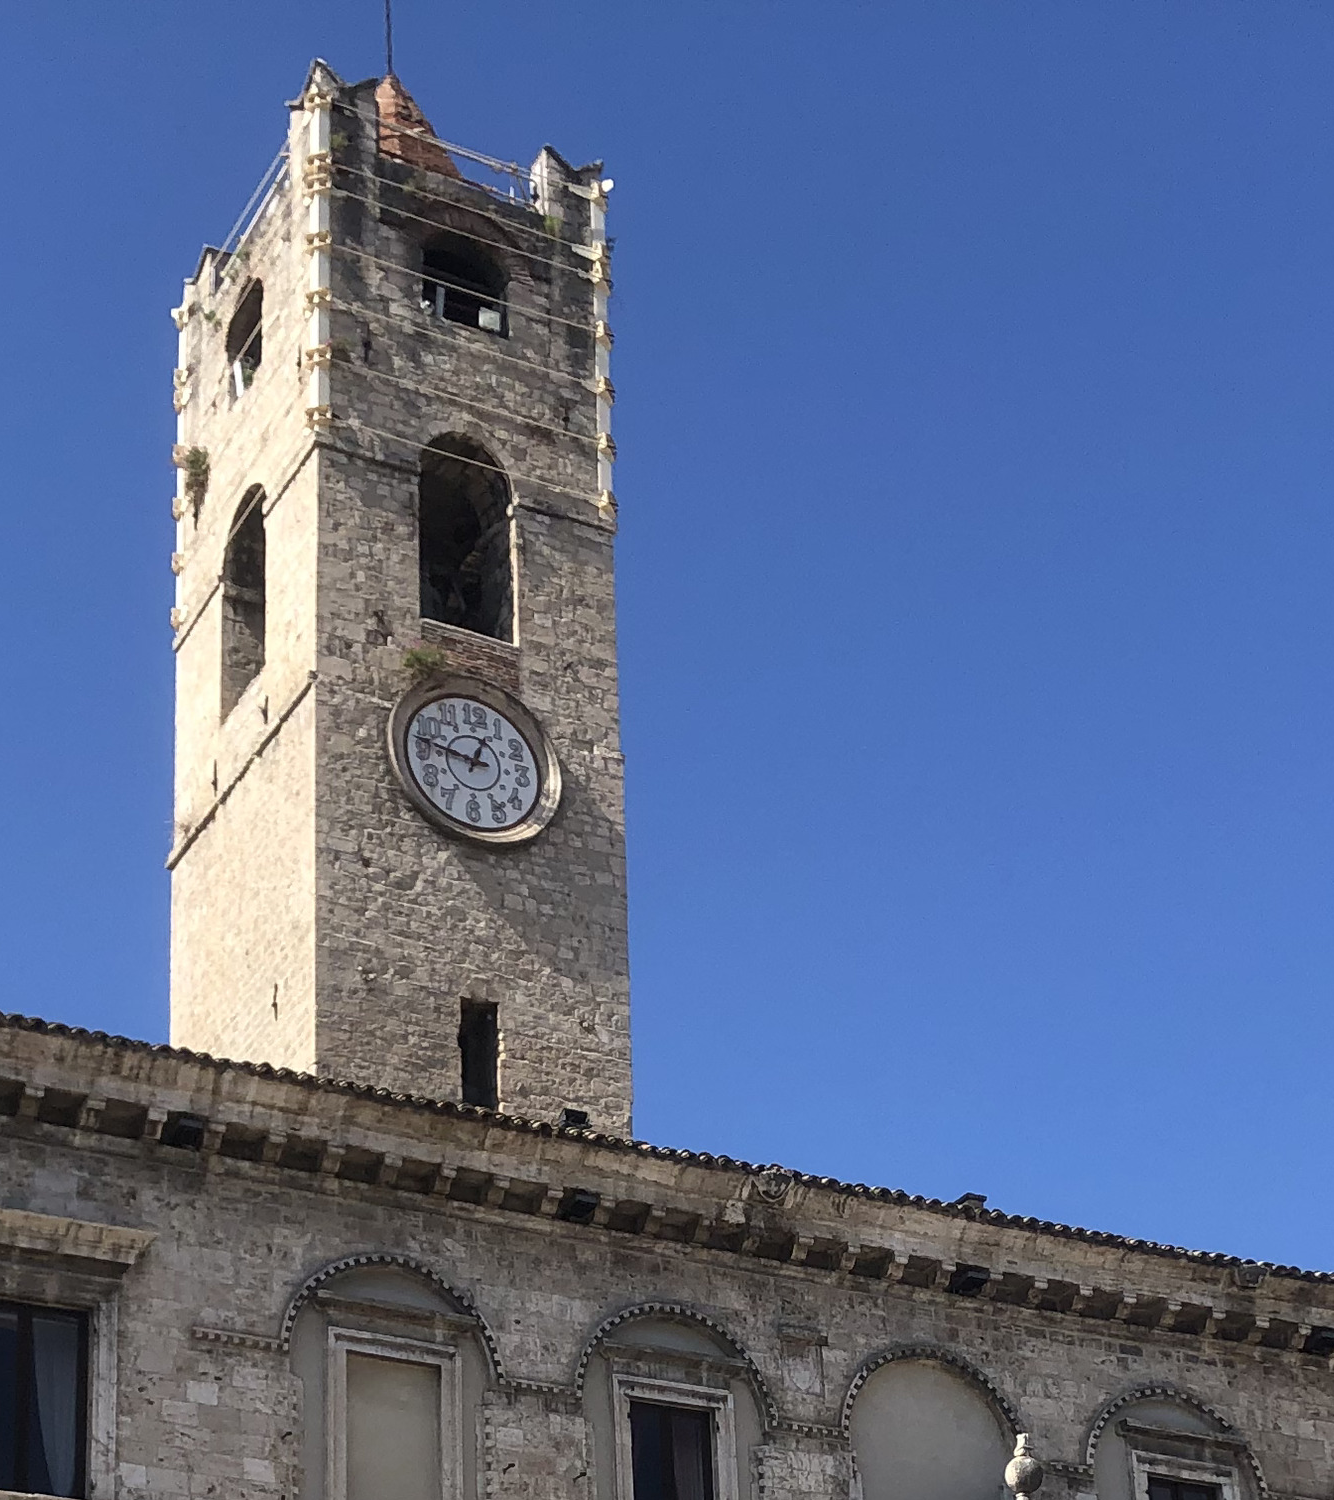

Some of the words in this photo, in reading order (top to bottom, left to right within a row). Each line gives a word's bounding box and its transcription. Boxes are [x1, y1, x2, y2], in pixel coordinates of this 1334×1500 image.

[416, 713, 442, 738] 10
[438, 702, 458, 727] 11
[462, 702, 488, 731] 12
[493, 717, 503, 741] 1
[415, 738, 432, 761] 9
[508, 738, 524, 762] 2
[422, 763, 439, 788] 8
[515, 764, 531, 788] 3
[440, 783, 460, 811] 7
[507, 787, 523, 811] 4
[465, 797, 482, 823] 6
[490, 796, 507, 824] 5
